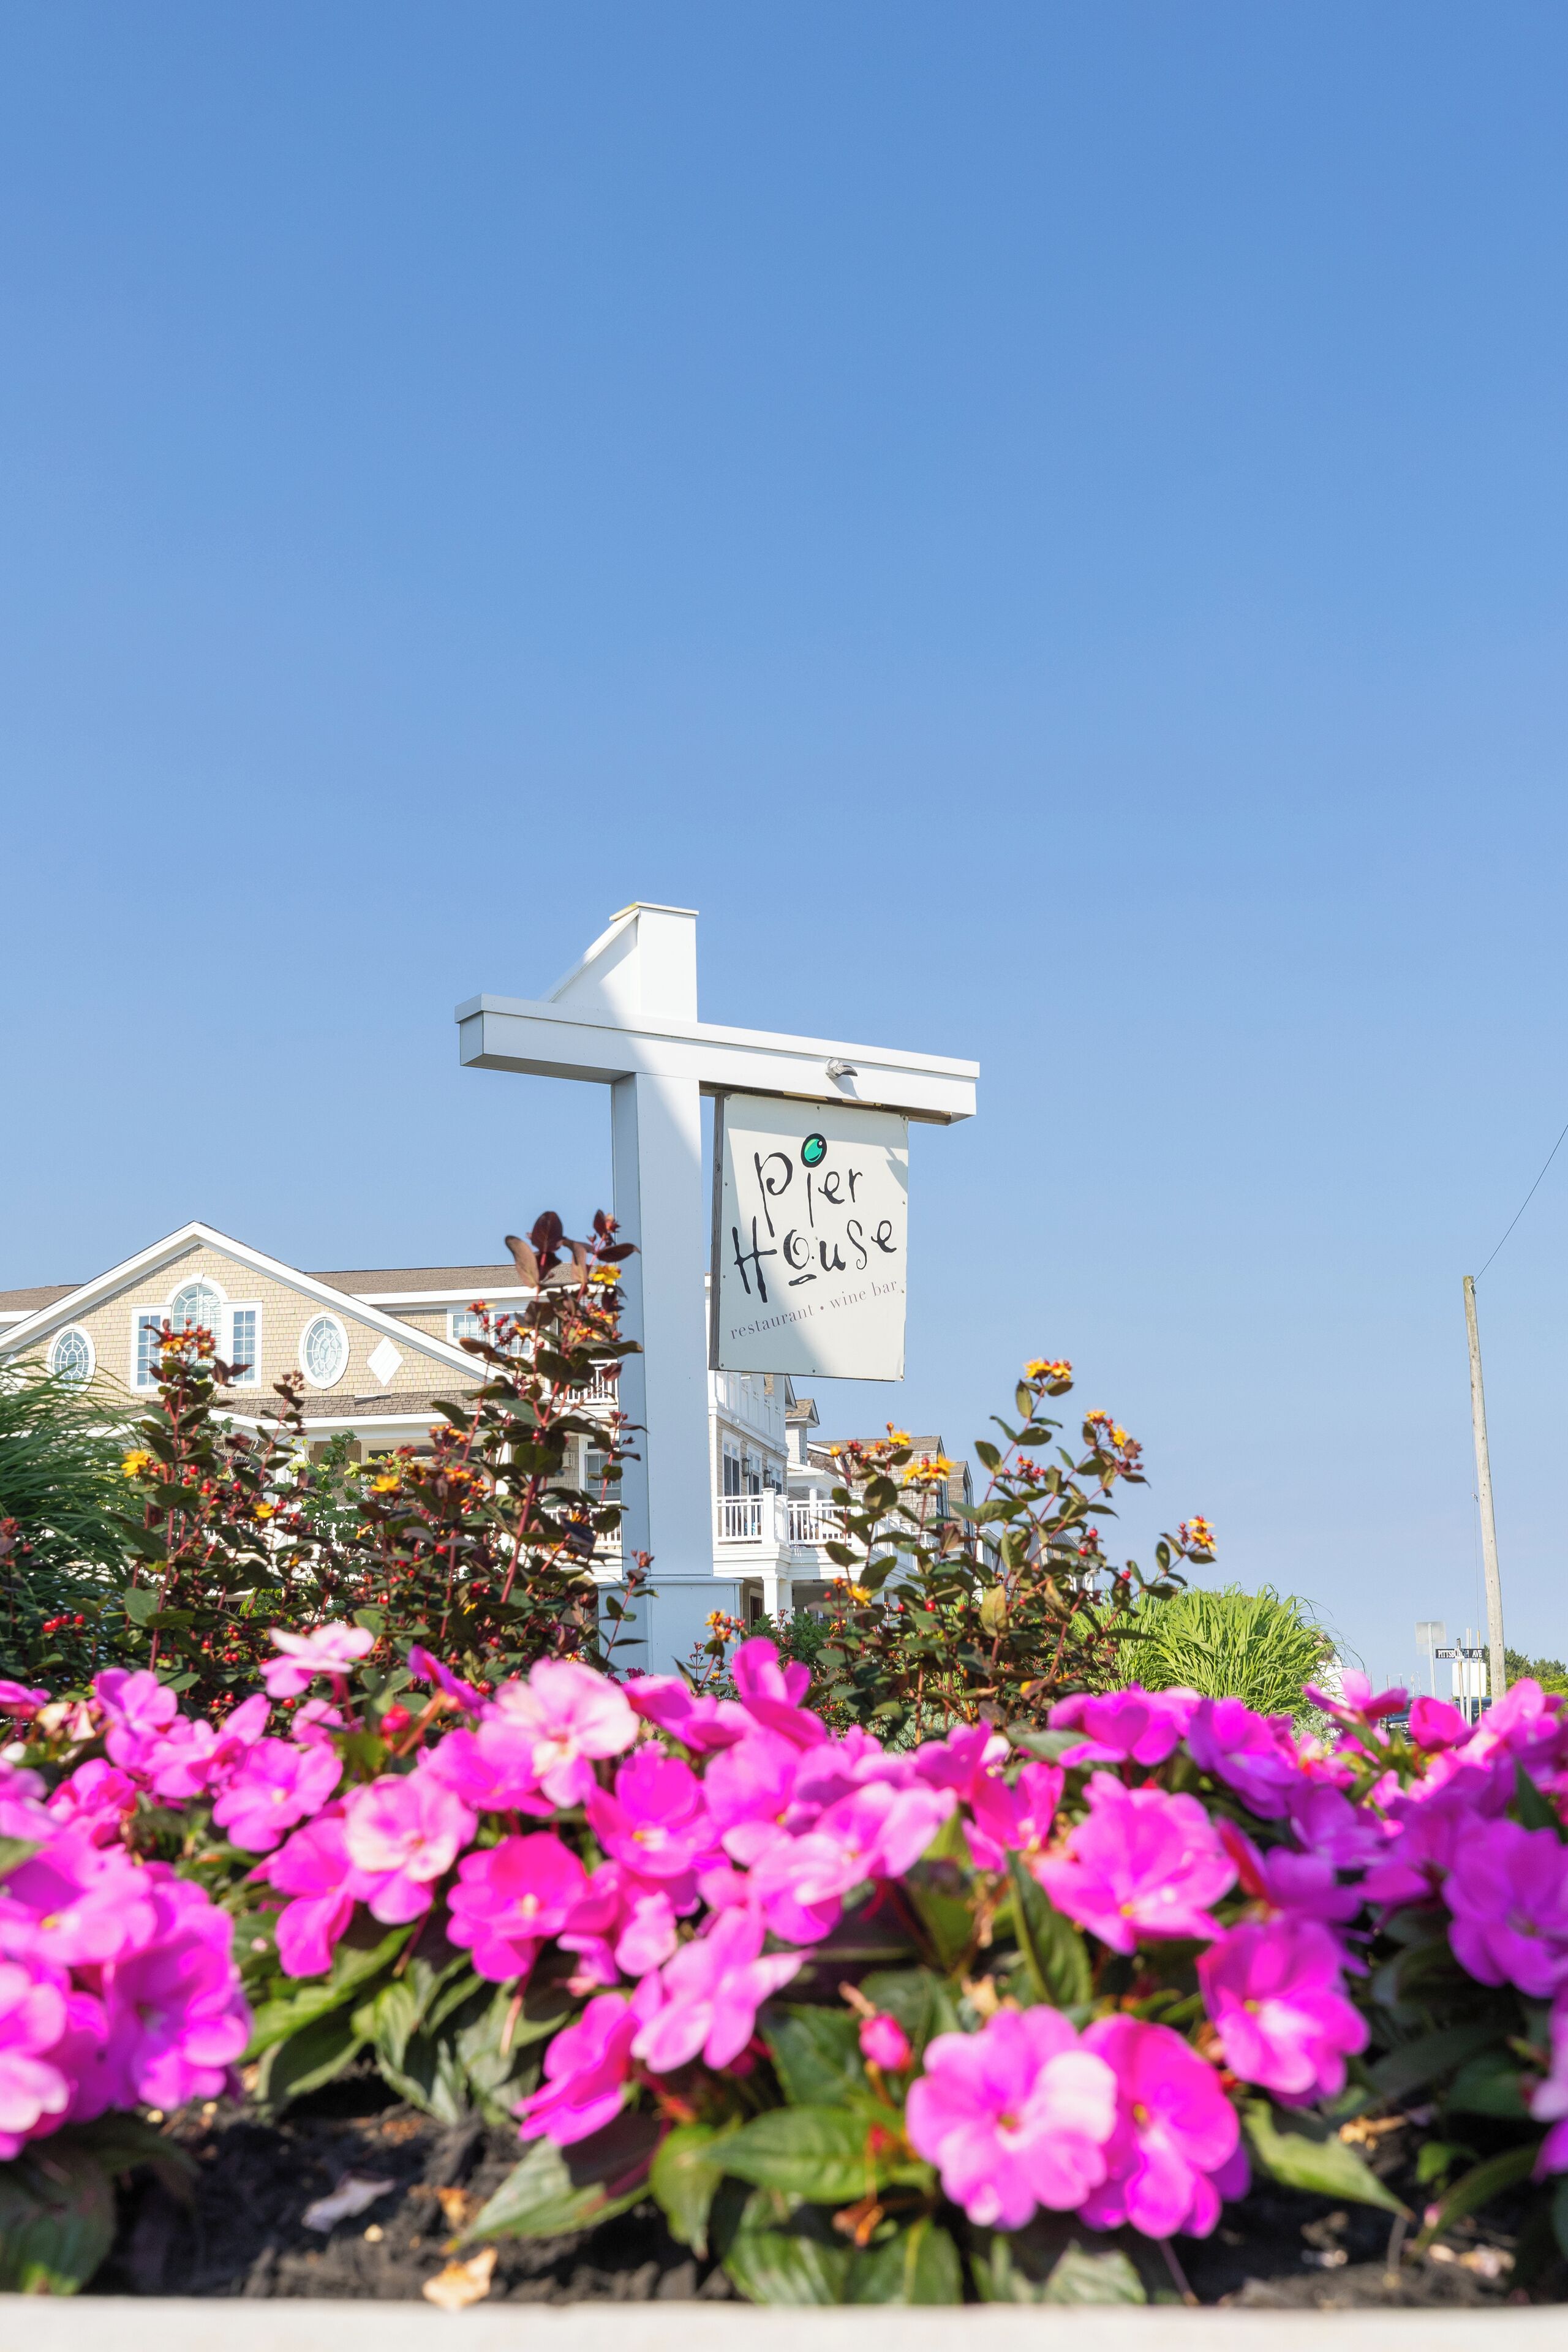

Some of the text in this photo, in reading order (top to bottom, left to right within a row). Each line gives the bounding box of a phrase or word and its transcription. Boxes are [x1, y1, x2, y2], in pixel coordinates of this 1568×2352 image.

[732, 1216, 897, 1303] House
[731, 1281, 897, 1340] restaurant wine bar
[1472, 1649, 1482, 1658] AVE
